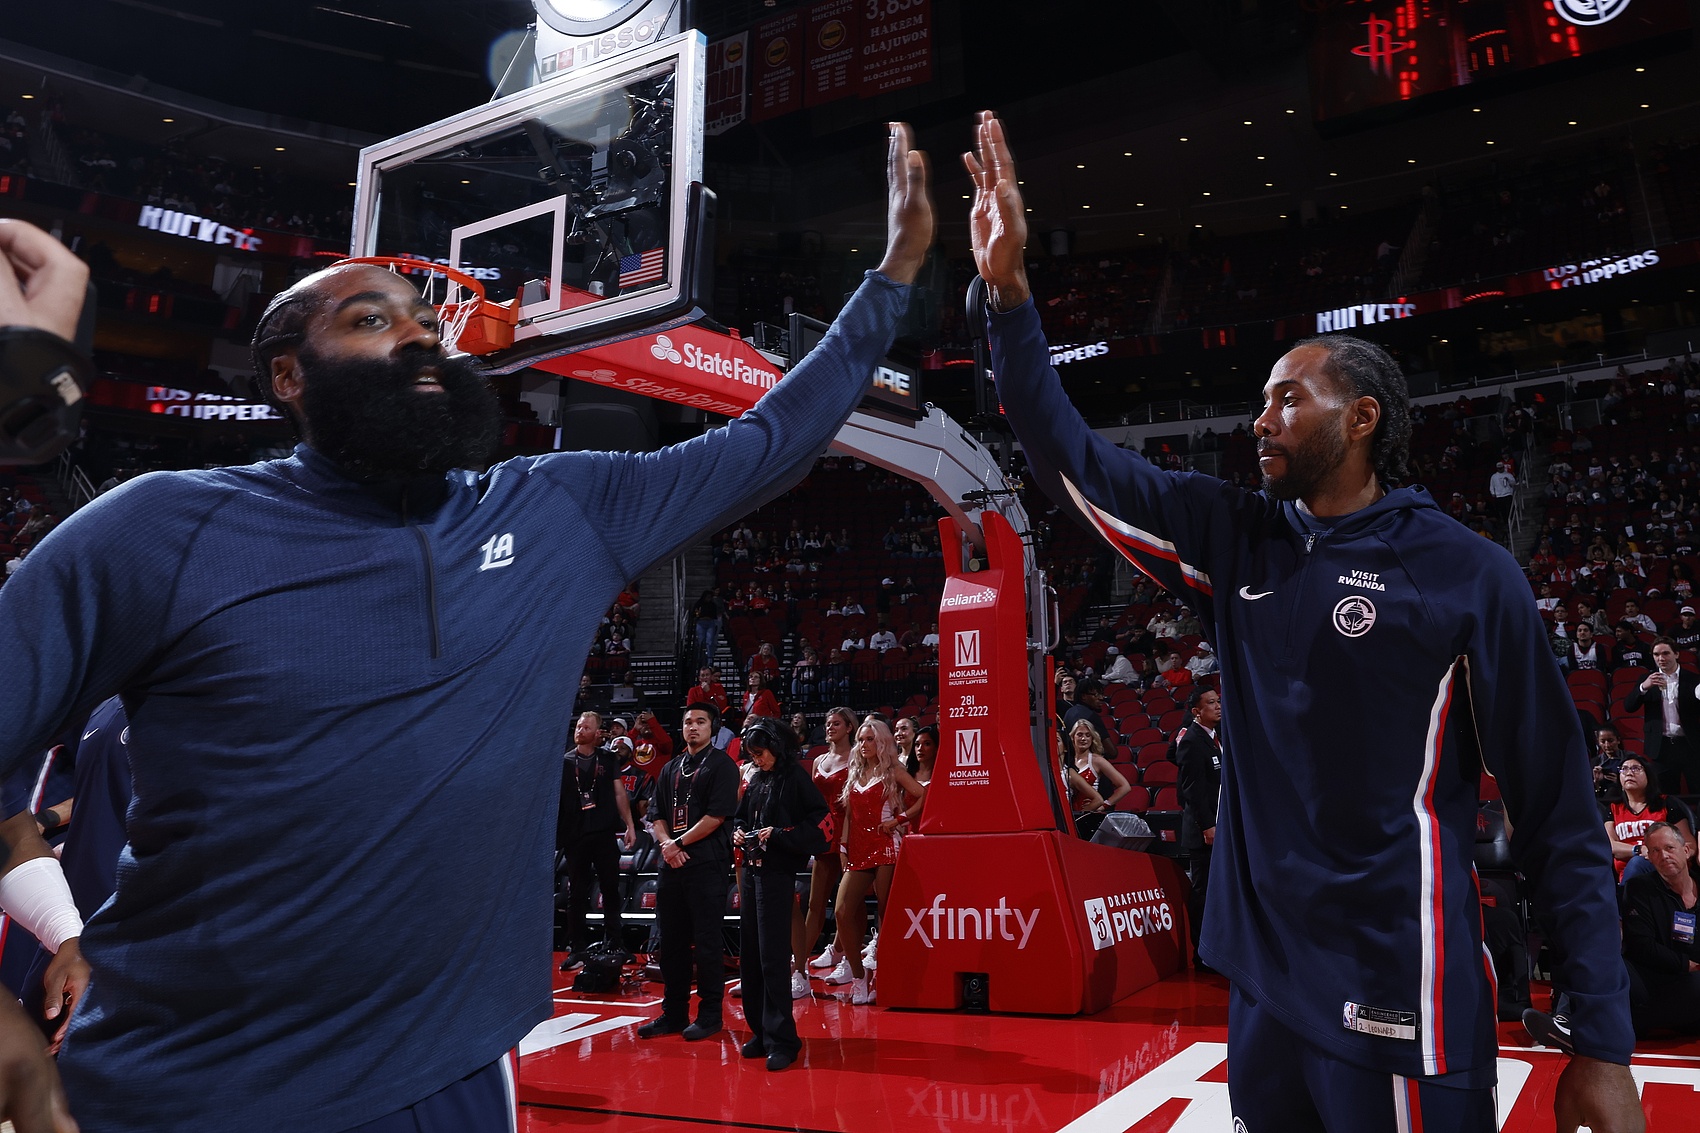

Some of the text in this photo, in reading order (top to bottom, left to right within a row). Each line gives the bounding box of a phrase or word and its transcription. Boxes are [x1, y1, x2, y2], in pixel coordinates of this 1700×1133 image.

[811, 5, 853, 22] ROCKETS
[870, 14, 923, 38] HAKEEM
[577, 14, 667, 62] TISSOT
[863, 28, 928, 56] OLAJUWON
[888, 48, 928, 64] ALL-TIME
[863, 60, 928, 82] BLOCKED SHOTS
[879, 76, 912, 90] LEADER
[477, 532, 516, 572] LA
[1338, 575, 1386, 591] RWANDA
[1351, 569, 1379, 582] VISIT
[942, 592, 983, 606] reliant
[949, 669, 988, 678] MOKARAM
[960, 695, 975, 706] 281
[949, 705, 988, 718] 222-2222
[949, 770, 989, 779] MOKARAM
[1107, 887, 1165, 908] DRAFTKINGS
[903, 893, 1041, 950] xfinity
